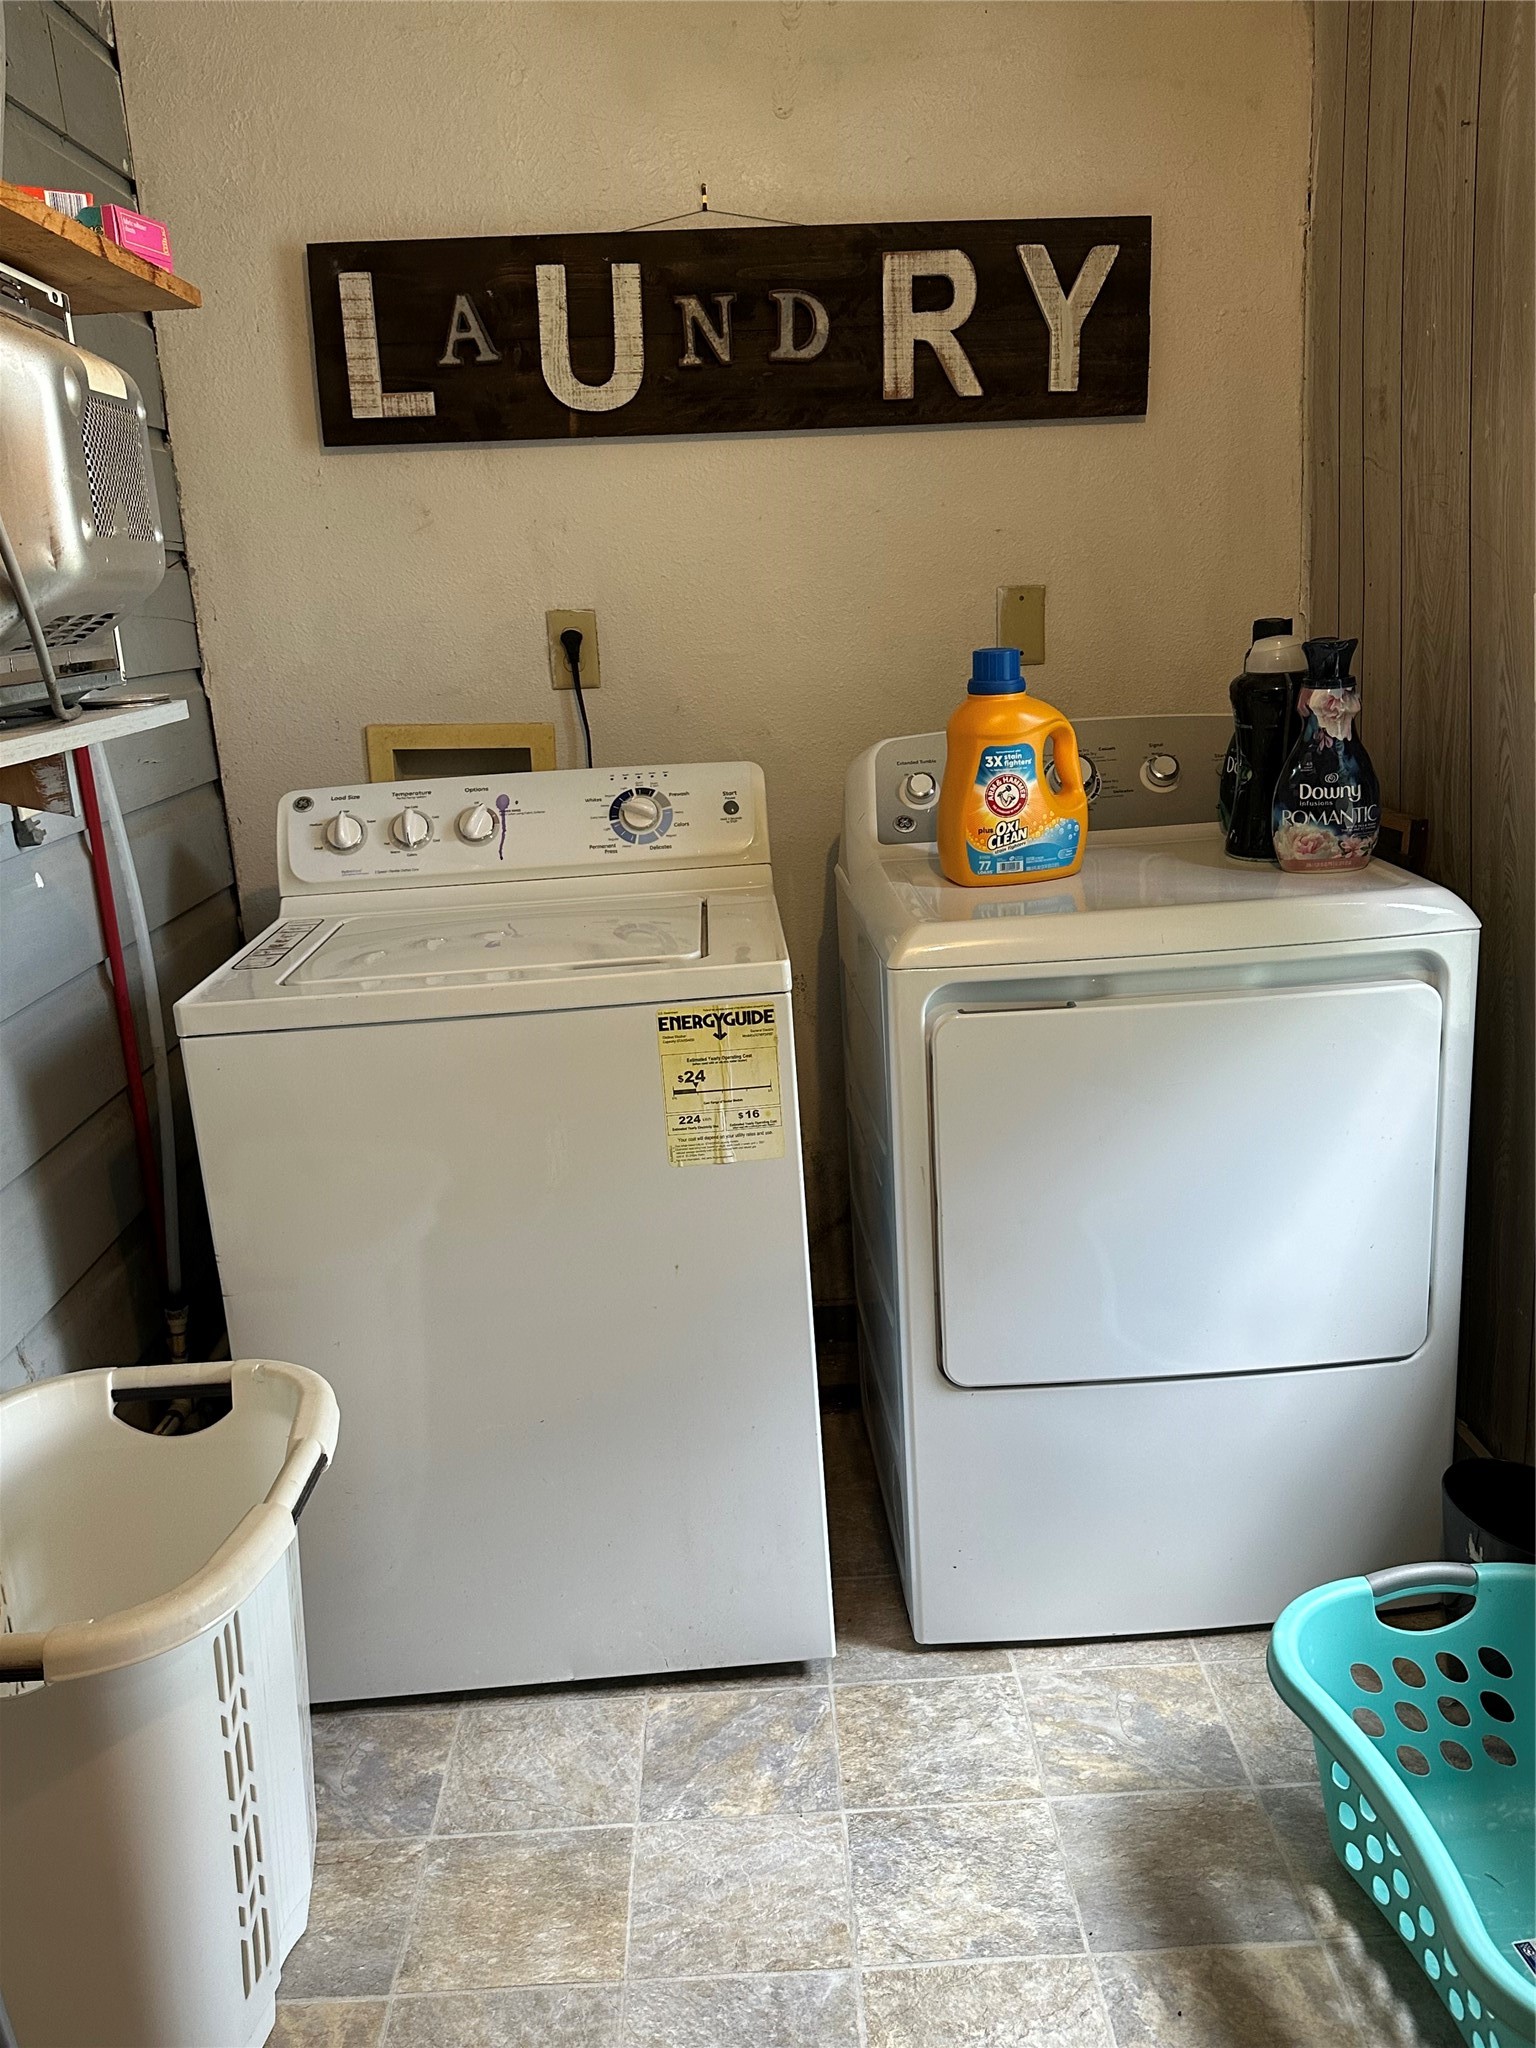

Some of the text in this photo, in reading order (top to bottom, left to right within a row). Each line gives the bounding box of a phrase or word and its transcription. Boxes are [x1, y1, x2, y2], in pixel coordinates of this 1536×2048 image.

[985, 755, 1003, 768] 3X
[391, 790, 432, 798] Temperature
[988, 776, 1026, 801] ARM & HAMMER
[1300, 783, 1361, 802] Downy
[1282, 804, 1378, 826] ROMANTIC
[978, 827, 993, 835] plus
[996, 820, 1019, 834] OXI
[988, 827, 1028, 850] CLEAN
[979, 861, 991, 870] 77
[658, 1009, 775, 1032] ENERGYGUIDE
[678, 1069, 706, 1084] $24
[679, 1115, 701, 1125] 224
